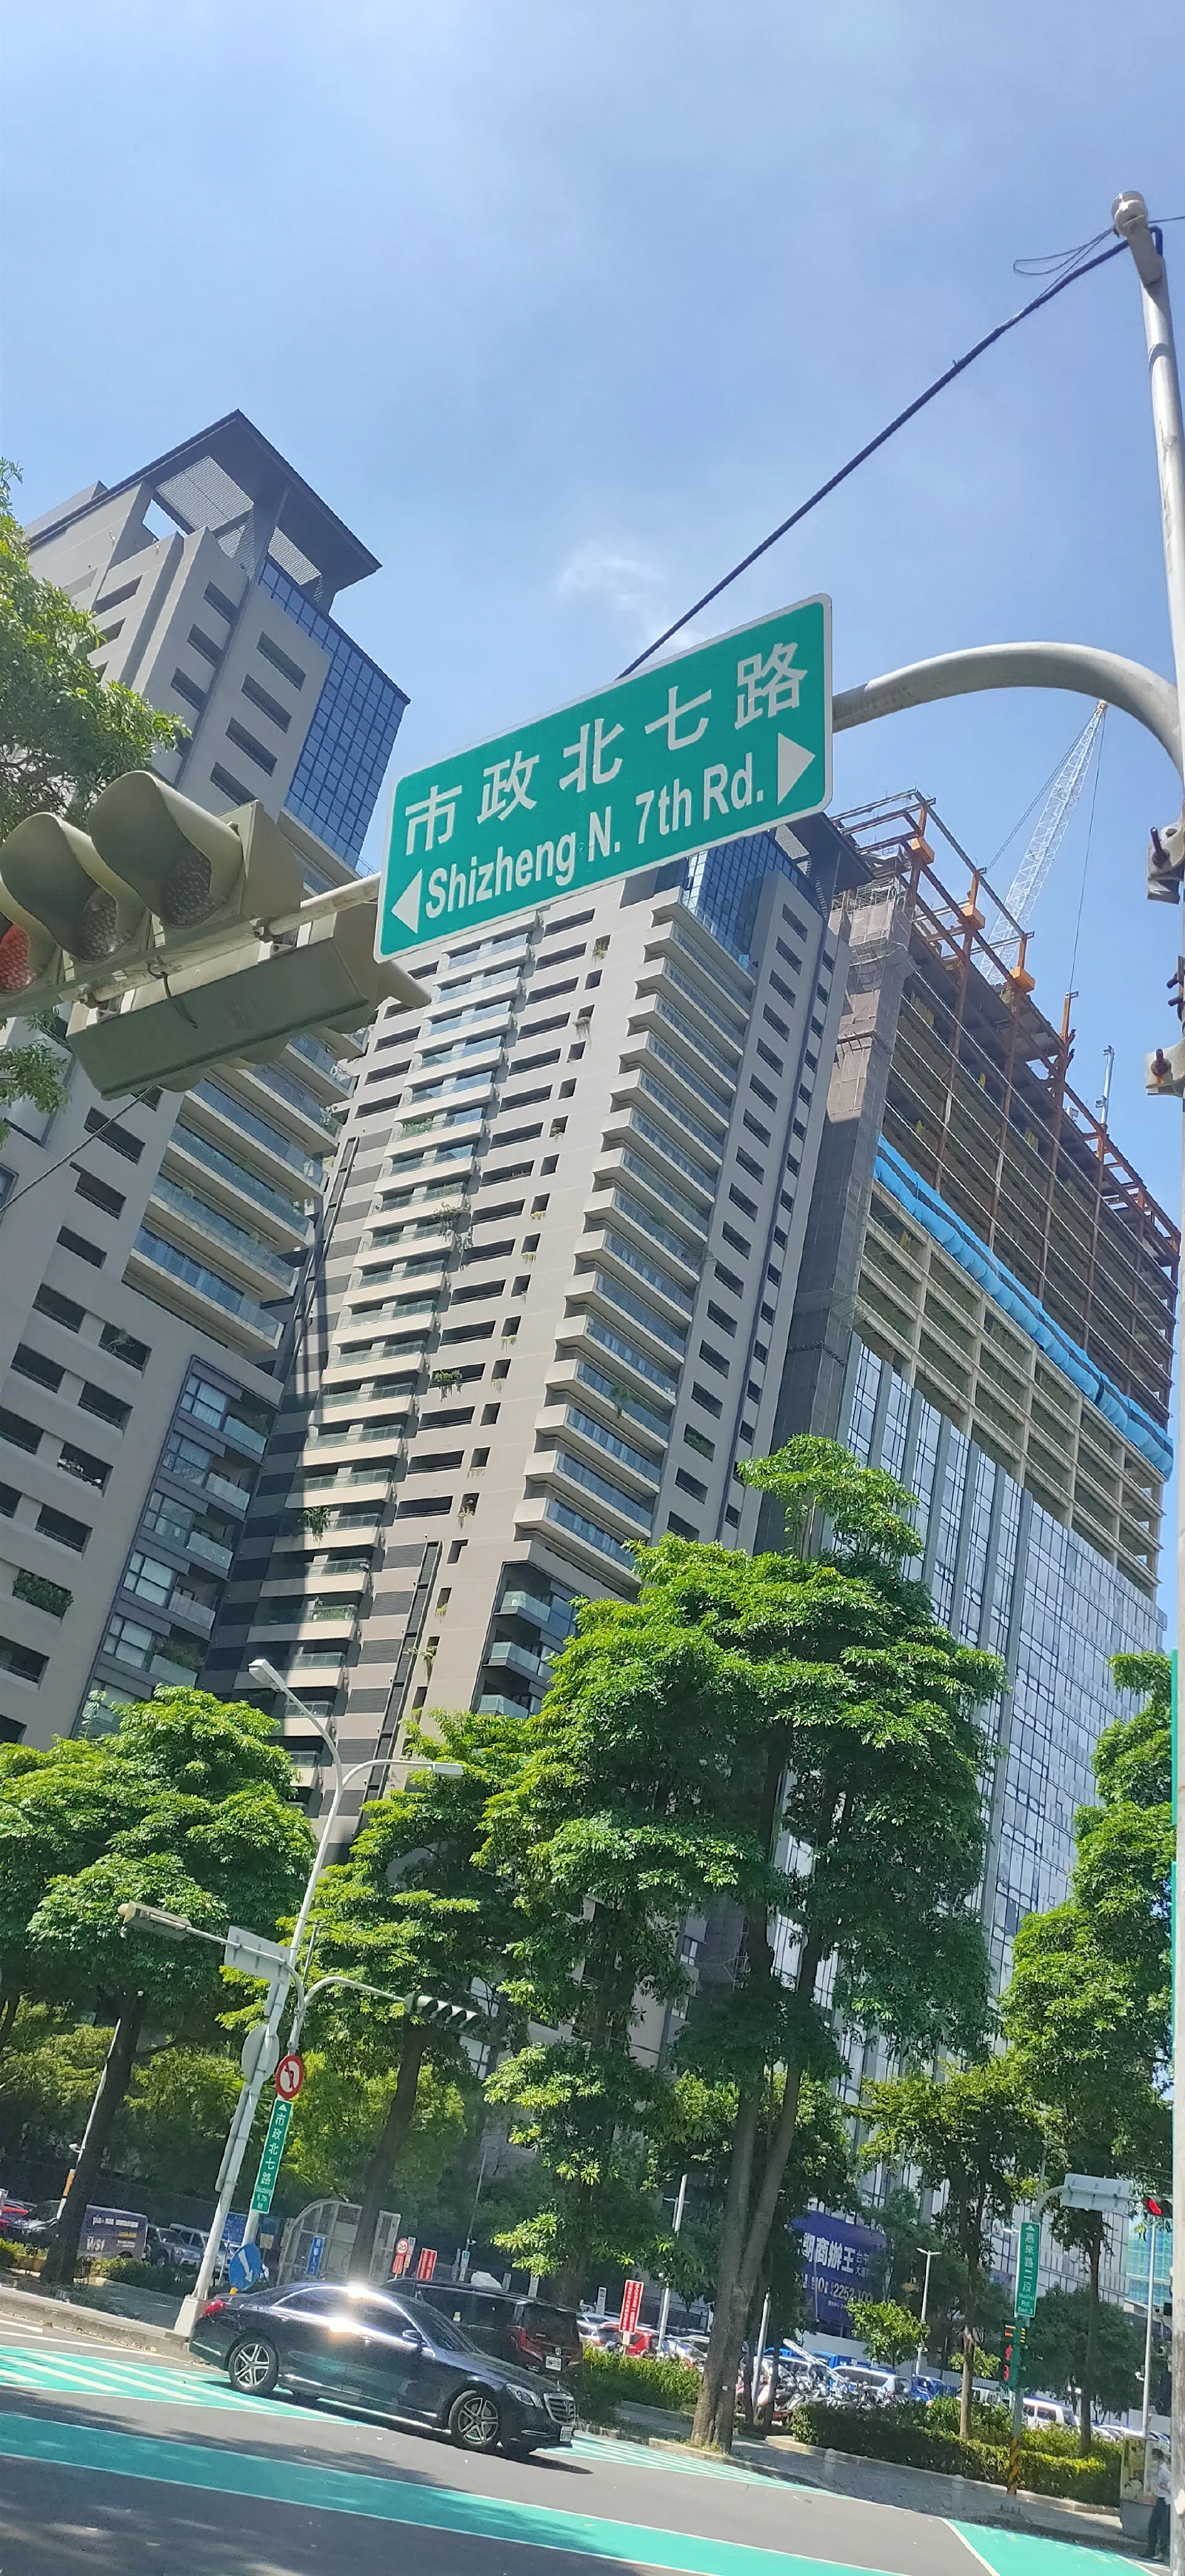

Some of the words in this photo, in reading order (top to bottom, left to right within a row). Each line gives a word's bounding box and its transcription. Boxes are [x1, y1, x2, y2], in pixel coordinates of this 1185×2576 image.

[404, 641, 808, 856] 市政北七路
[425, 831, 576, 919] Shizheng
[587, 811, 621, 862] N.
[635, 779, 692, 844] 7th
[703, 753, 764, 821] Rd.
[261, 2112, 287, 2185] 市政北七路
[1022, 2232, 1035, 2293] 惠來路二段
